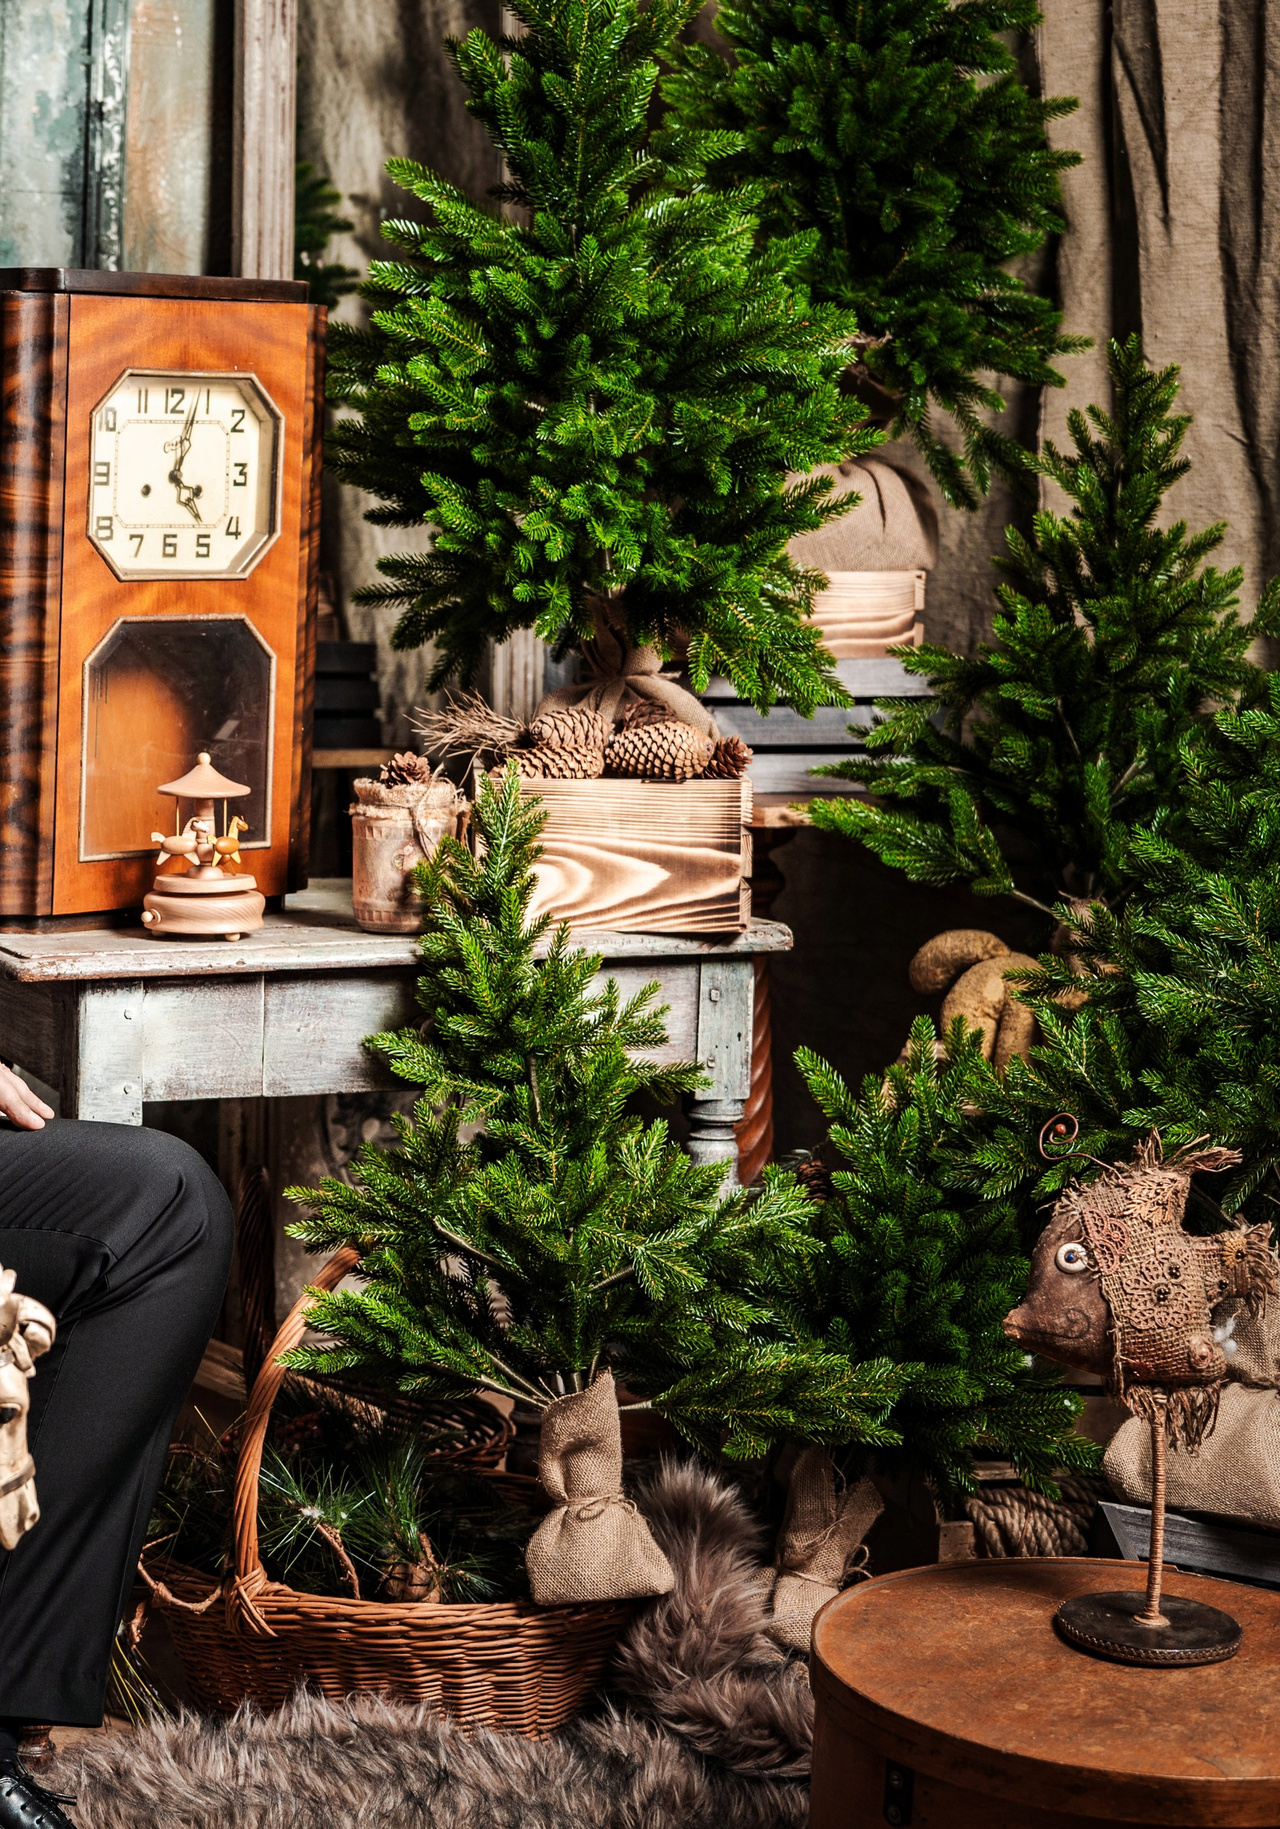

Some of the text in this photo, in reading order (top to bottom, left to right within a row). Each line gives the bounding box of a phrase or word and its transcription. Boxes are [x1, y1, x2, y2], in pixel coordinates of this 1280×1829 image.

[137, 388, 149, 414] 11
[165, 388, 185, 414] 12
[206, 388, 210, 415] 1
[98, 406, 117, 432] 10
[230, 409, 246, 433] 2
[94, 461, 110, 486] 9
[233, 462, 248, 487] 3
[95, 516, 114, 541] 8
[225, 516, 242, 540] 4
[129, 534, 144, 558] 7
[162, 534, 178, 558] 6
[195, 534, 211, 558] 5
